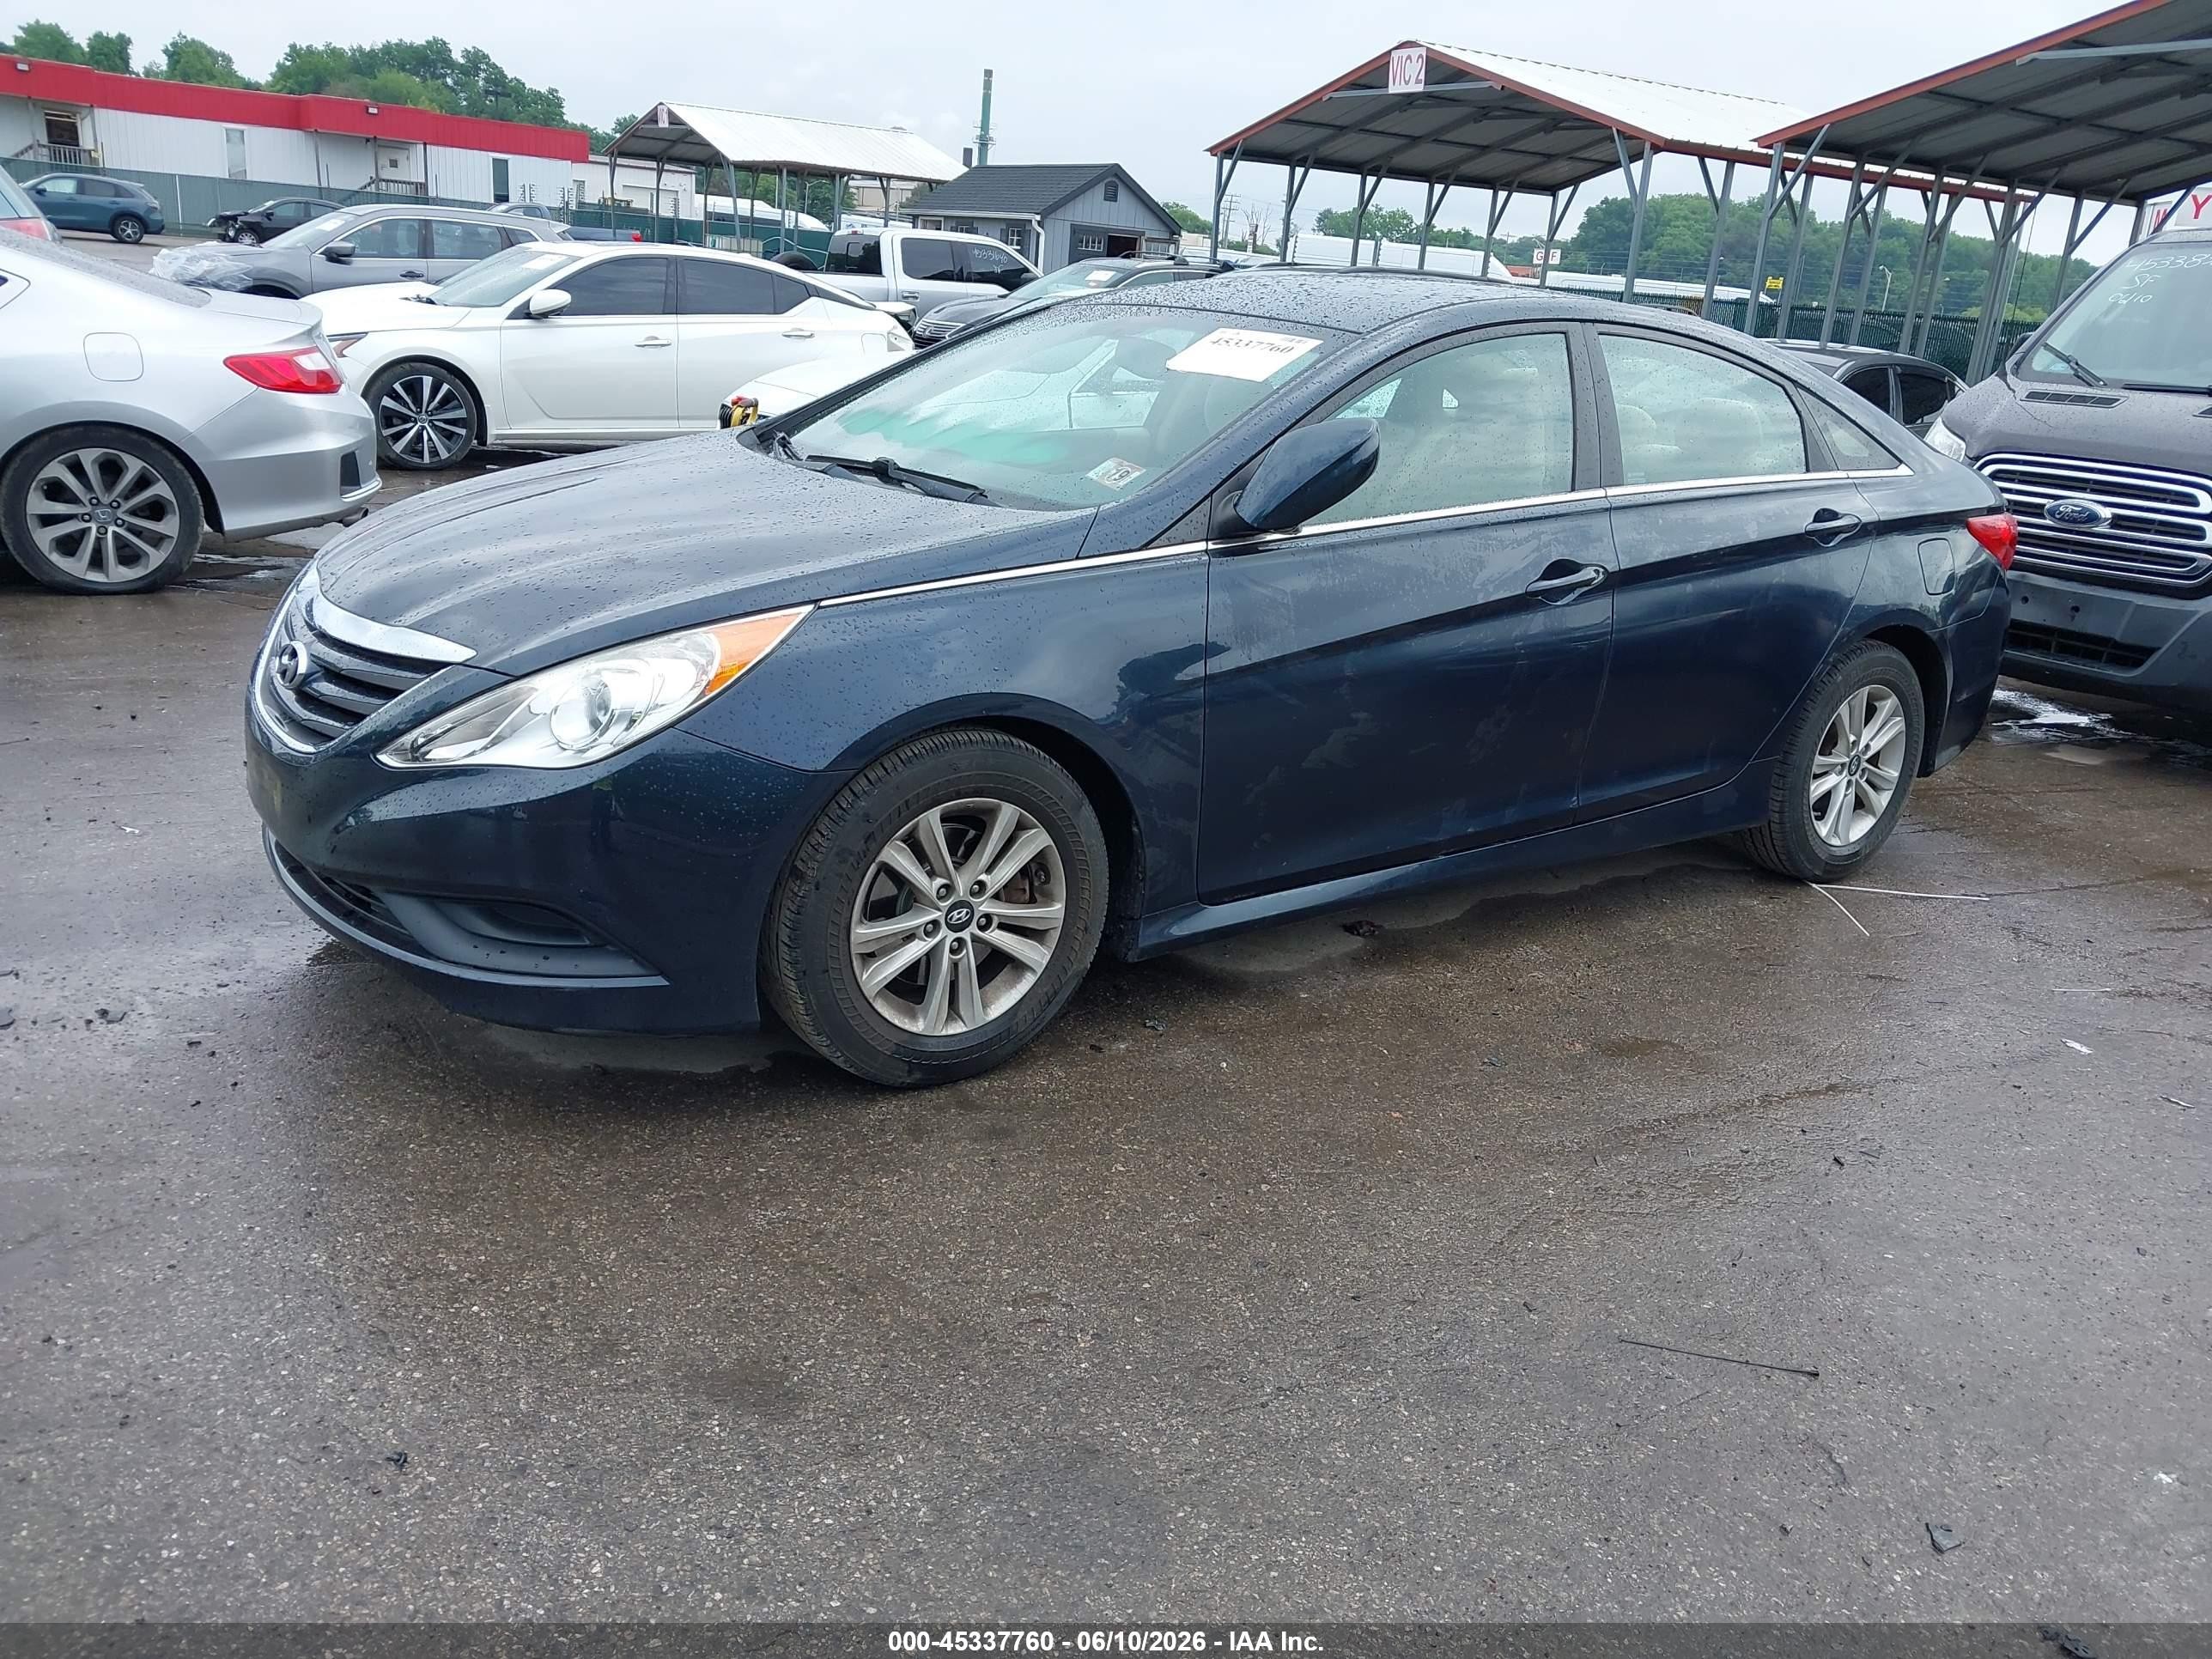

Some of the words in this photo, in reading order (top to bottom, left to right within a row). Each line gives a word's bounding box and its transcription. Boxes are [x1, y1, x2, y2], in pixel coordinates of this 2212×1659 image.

[1392, 54, 1413, 86] VIC
[1415, 53, 1424, 84] 2
[2120, 273, 2161, 289] SF
[2055, 504, 2090, 521] Ford
